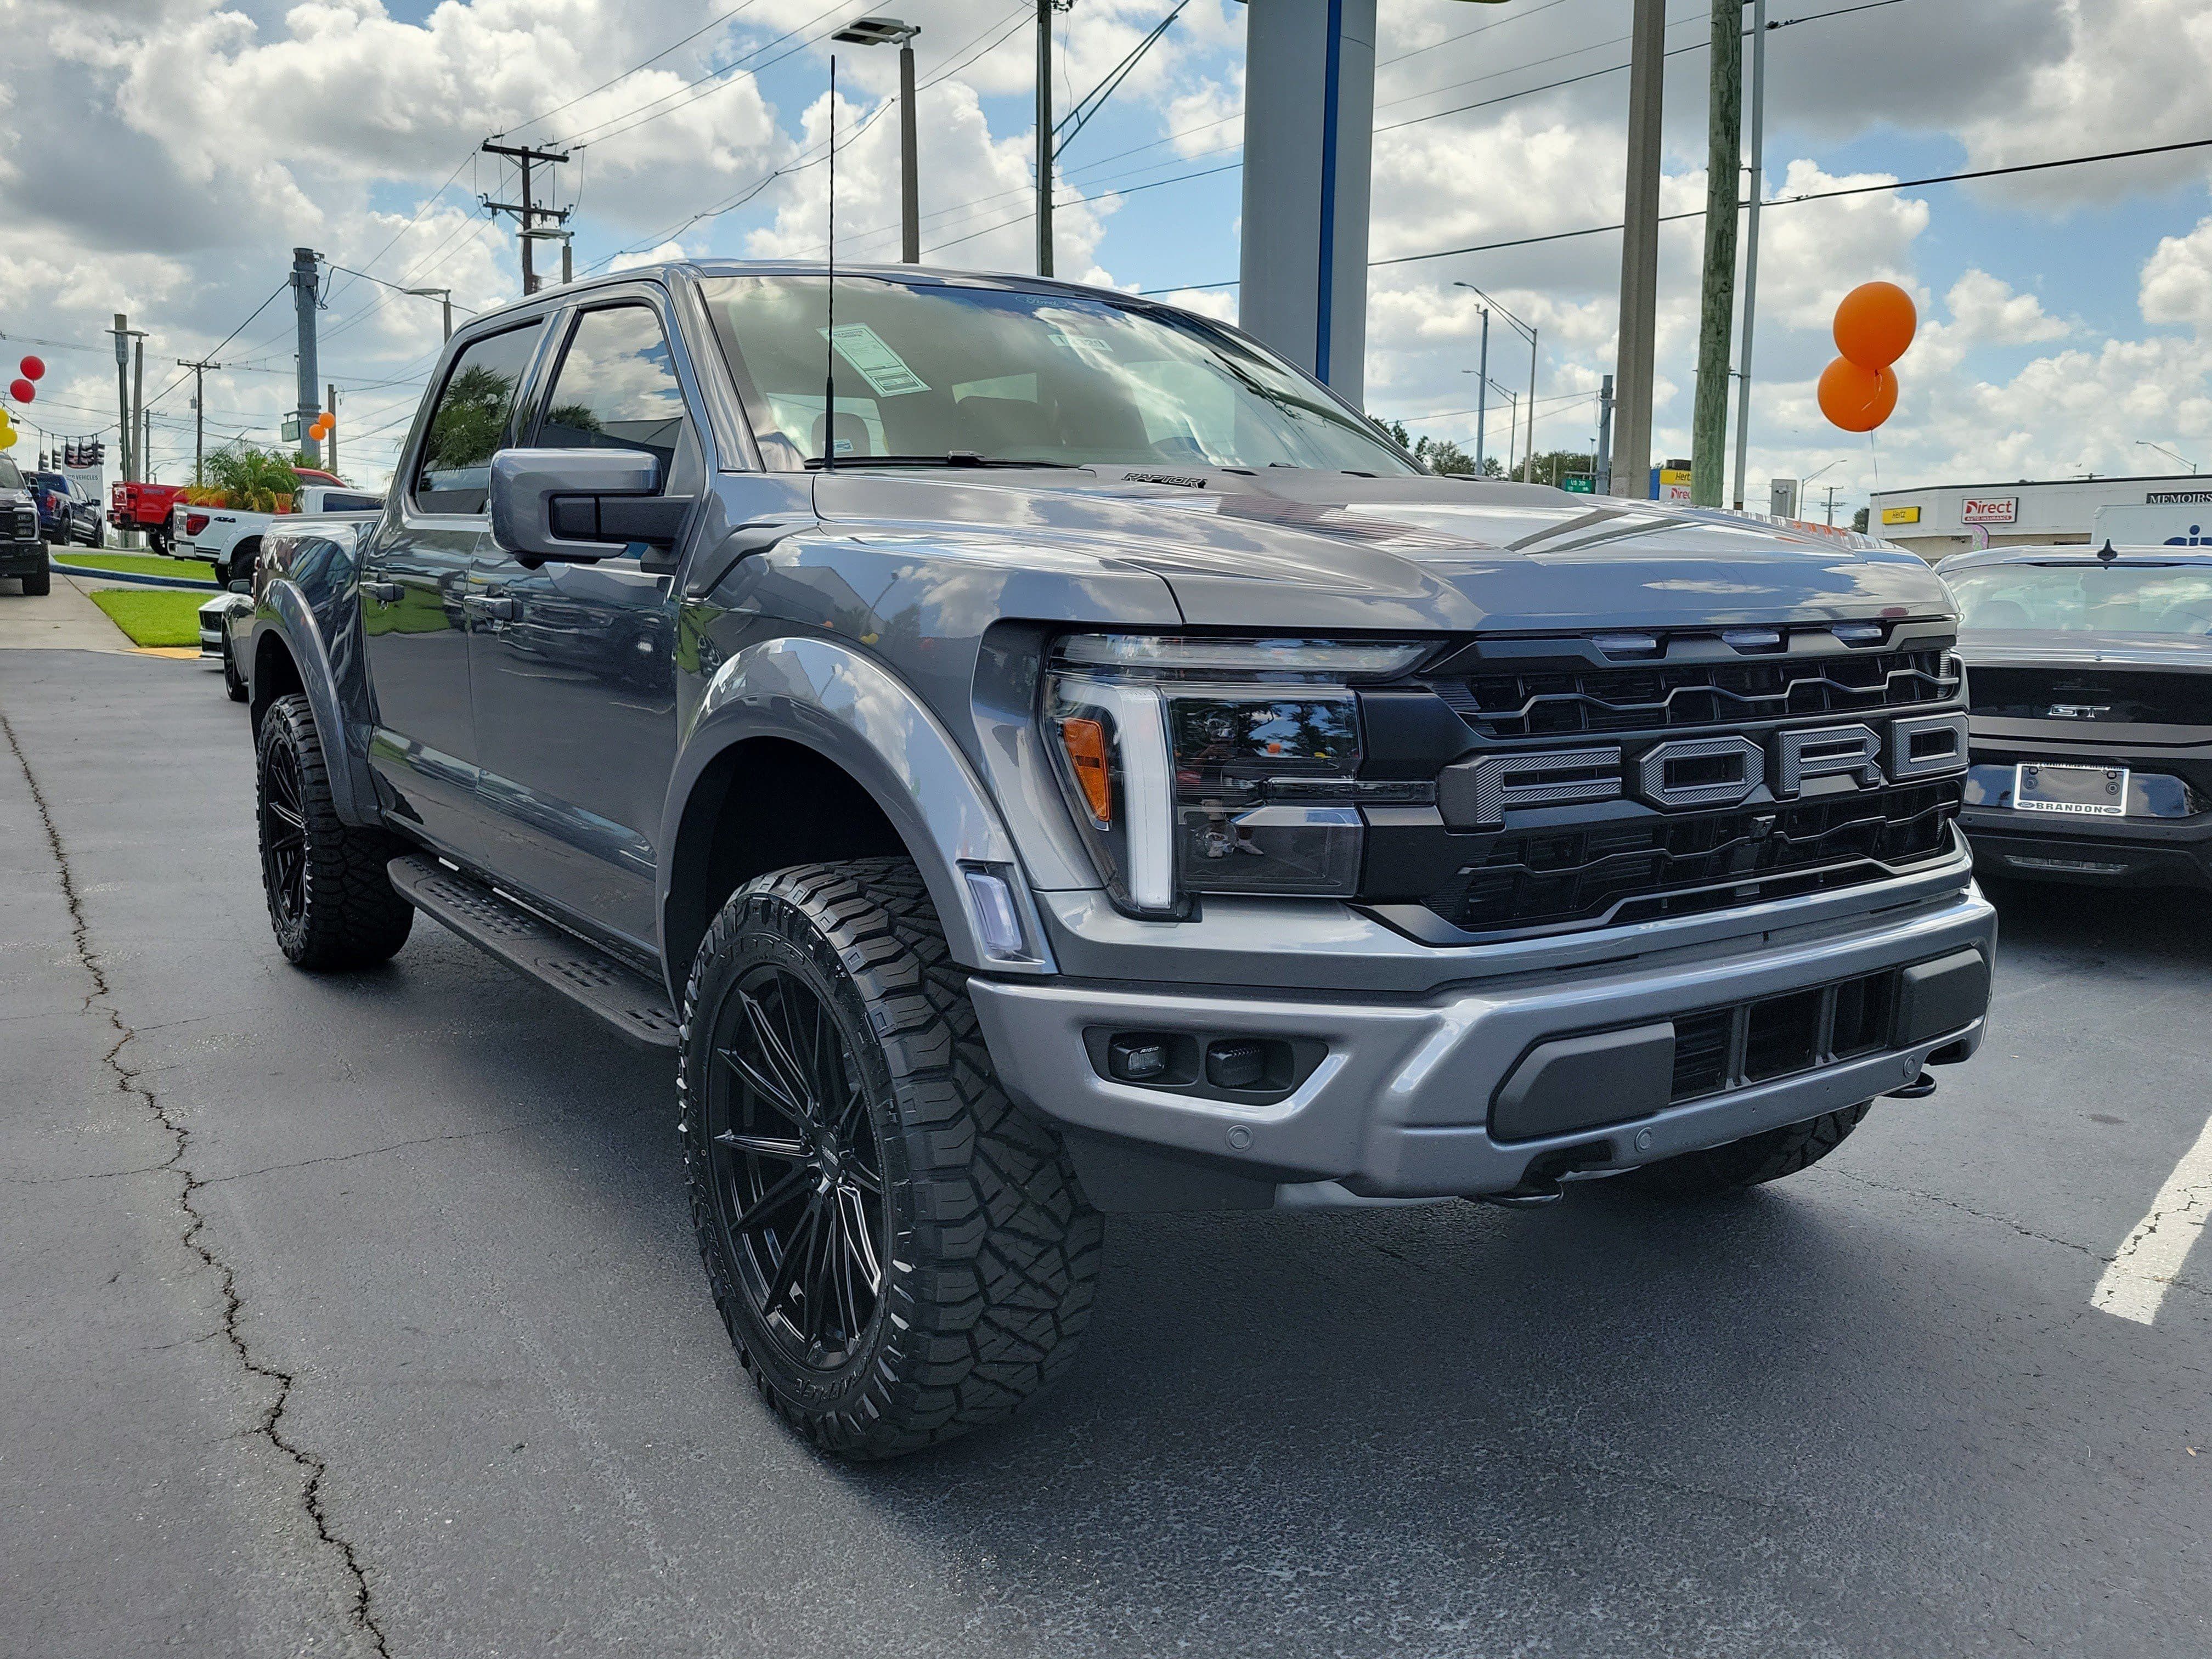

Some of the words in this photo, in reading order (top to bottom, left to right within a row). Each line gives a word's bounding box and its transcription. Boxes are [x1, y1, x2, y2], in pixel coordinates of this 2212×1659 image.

[1123, 473, 1201, 488] RAPTOR
[2149, 494, 2212, 503] MEMOIRS
[1966, 500, 2012, 514] Direct
[2048, 704, 2111, 718] GT
[1476, 711, 1970, 824] FORD
[2036, 803, 2103, 813] BRANDON
